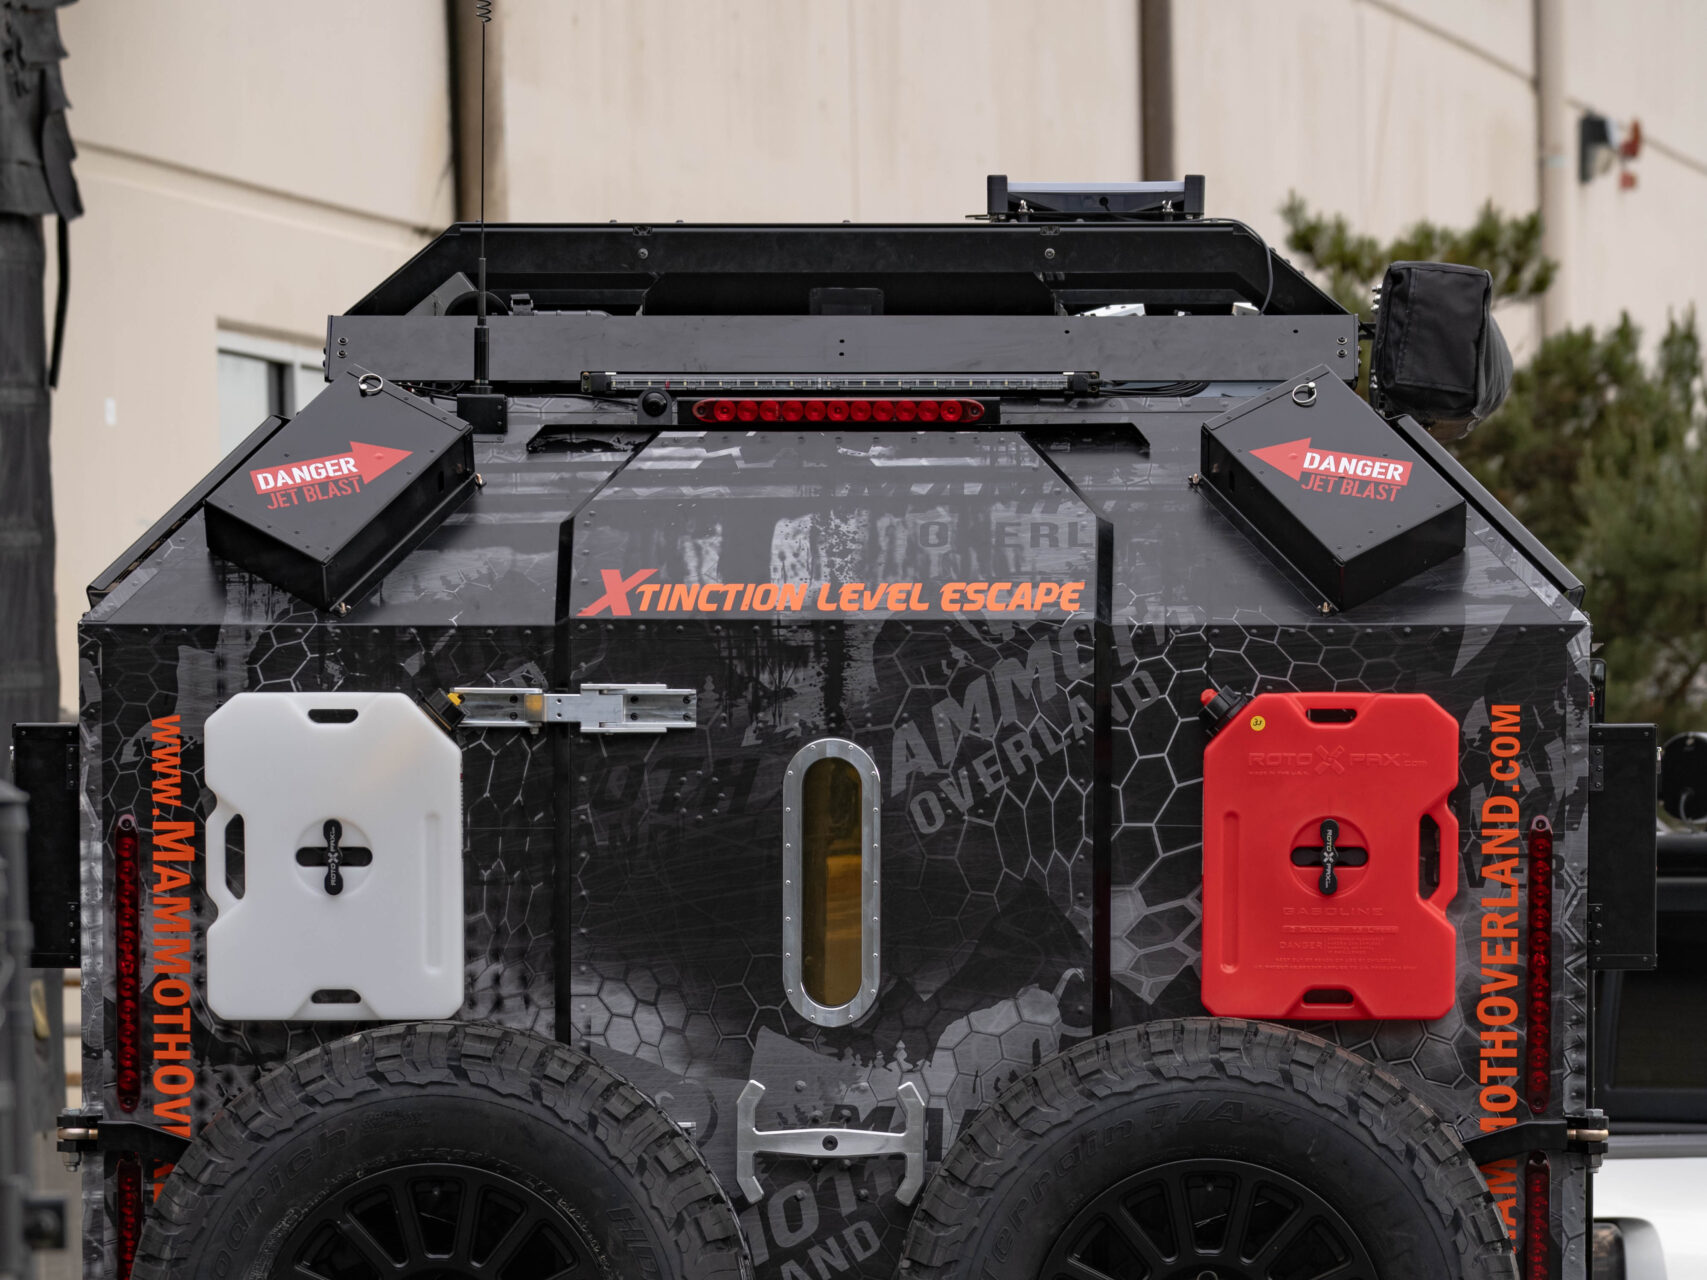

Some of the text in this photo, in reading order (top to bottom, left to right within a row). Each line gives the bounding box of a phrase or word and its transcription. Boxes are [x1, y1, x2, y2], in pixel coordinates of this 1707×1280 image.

[256, 457, 358, 490] DANGER
[1303, 452, 1404, 482] DANGER
[266, 476, 361, 509] JET BLAST
[1302, 473, 1401, 502] JET BLAST
[577, 568, 1086, 617] XTINCTION LEVEL ESCAPE
[1249, 752, 1313, 766] ROTO
